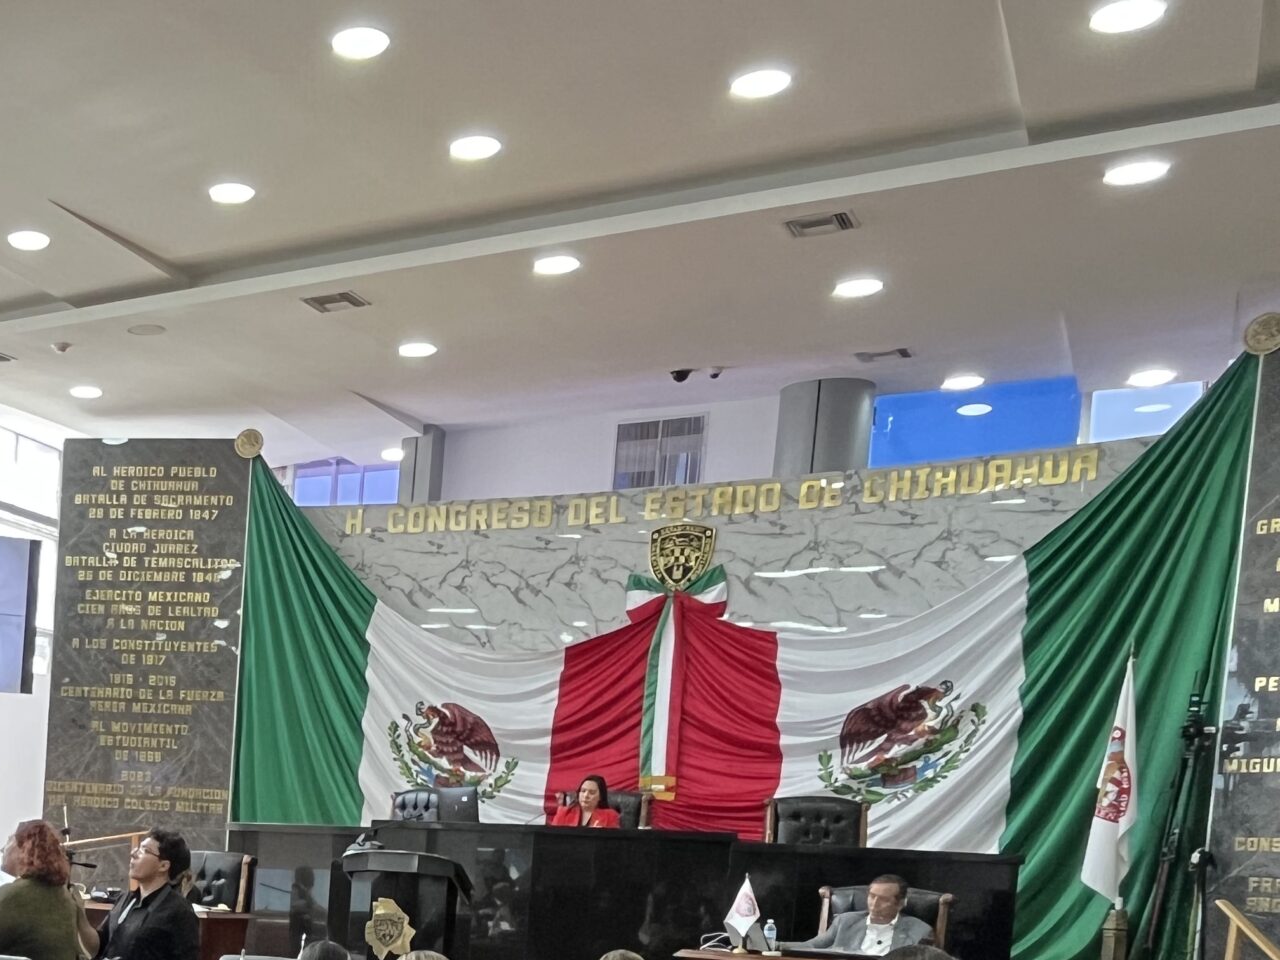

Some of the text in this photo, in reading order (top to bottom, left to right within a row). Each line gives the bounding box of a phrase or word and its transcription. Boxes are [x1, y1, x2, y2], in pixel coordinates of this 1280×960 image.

[92, 465, 217, 478] AL HEROICO PUEBLO
[110, 480, 199, 492] DE CHIHUAHUA
[386, 499, 556, 534] CONGRESO
[567, 495, 627, 527] DEL
[643, 482, 781, 521] ESTADO
[798, 475, 843, 509] DE
[862, 447, 1101, 505] CHIHUAHUA
[74, 494, 234, 507] BATALLA DE SACRAMENTO
[88, 508, 219, 521] 28 DE FEBRERO 1847
[109, 528, 195, 541] A LA HEROICA
[102, 542, 199, 555] CIUDAD JUAREZ
[65, 556, 118, 568] BATALLA
[123, 556, 137, 567] DE
[99, 570, 113, 581] DE
[120, 570, 186, 582] DICIEMBRE
[85, 589, 210, 603] EJERCITO MEXICANO
[77, 604, 105, 615] CIEN
[147, 604, 162, 616] DE
[168, 605, 219, 618] LEALTAD
[106, 618, 186, 631] A LA NACION
[72, 638, 218, 653] A LOS CONSTITUYENTES
[121, 653, 136, 665] DE
[61, 686, 225, 702] CENTENARIO DE LA FUERZA
[132, 702, 193, 715] MEXICANA
[91, 720, 189, 736] AL MOVIMIENTO
[99, 735, 178, 749] ESTUDIANTIL
[115, 750, 128, 761] DE
